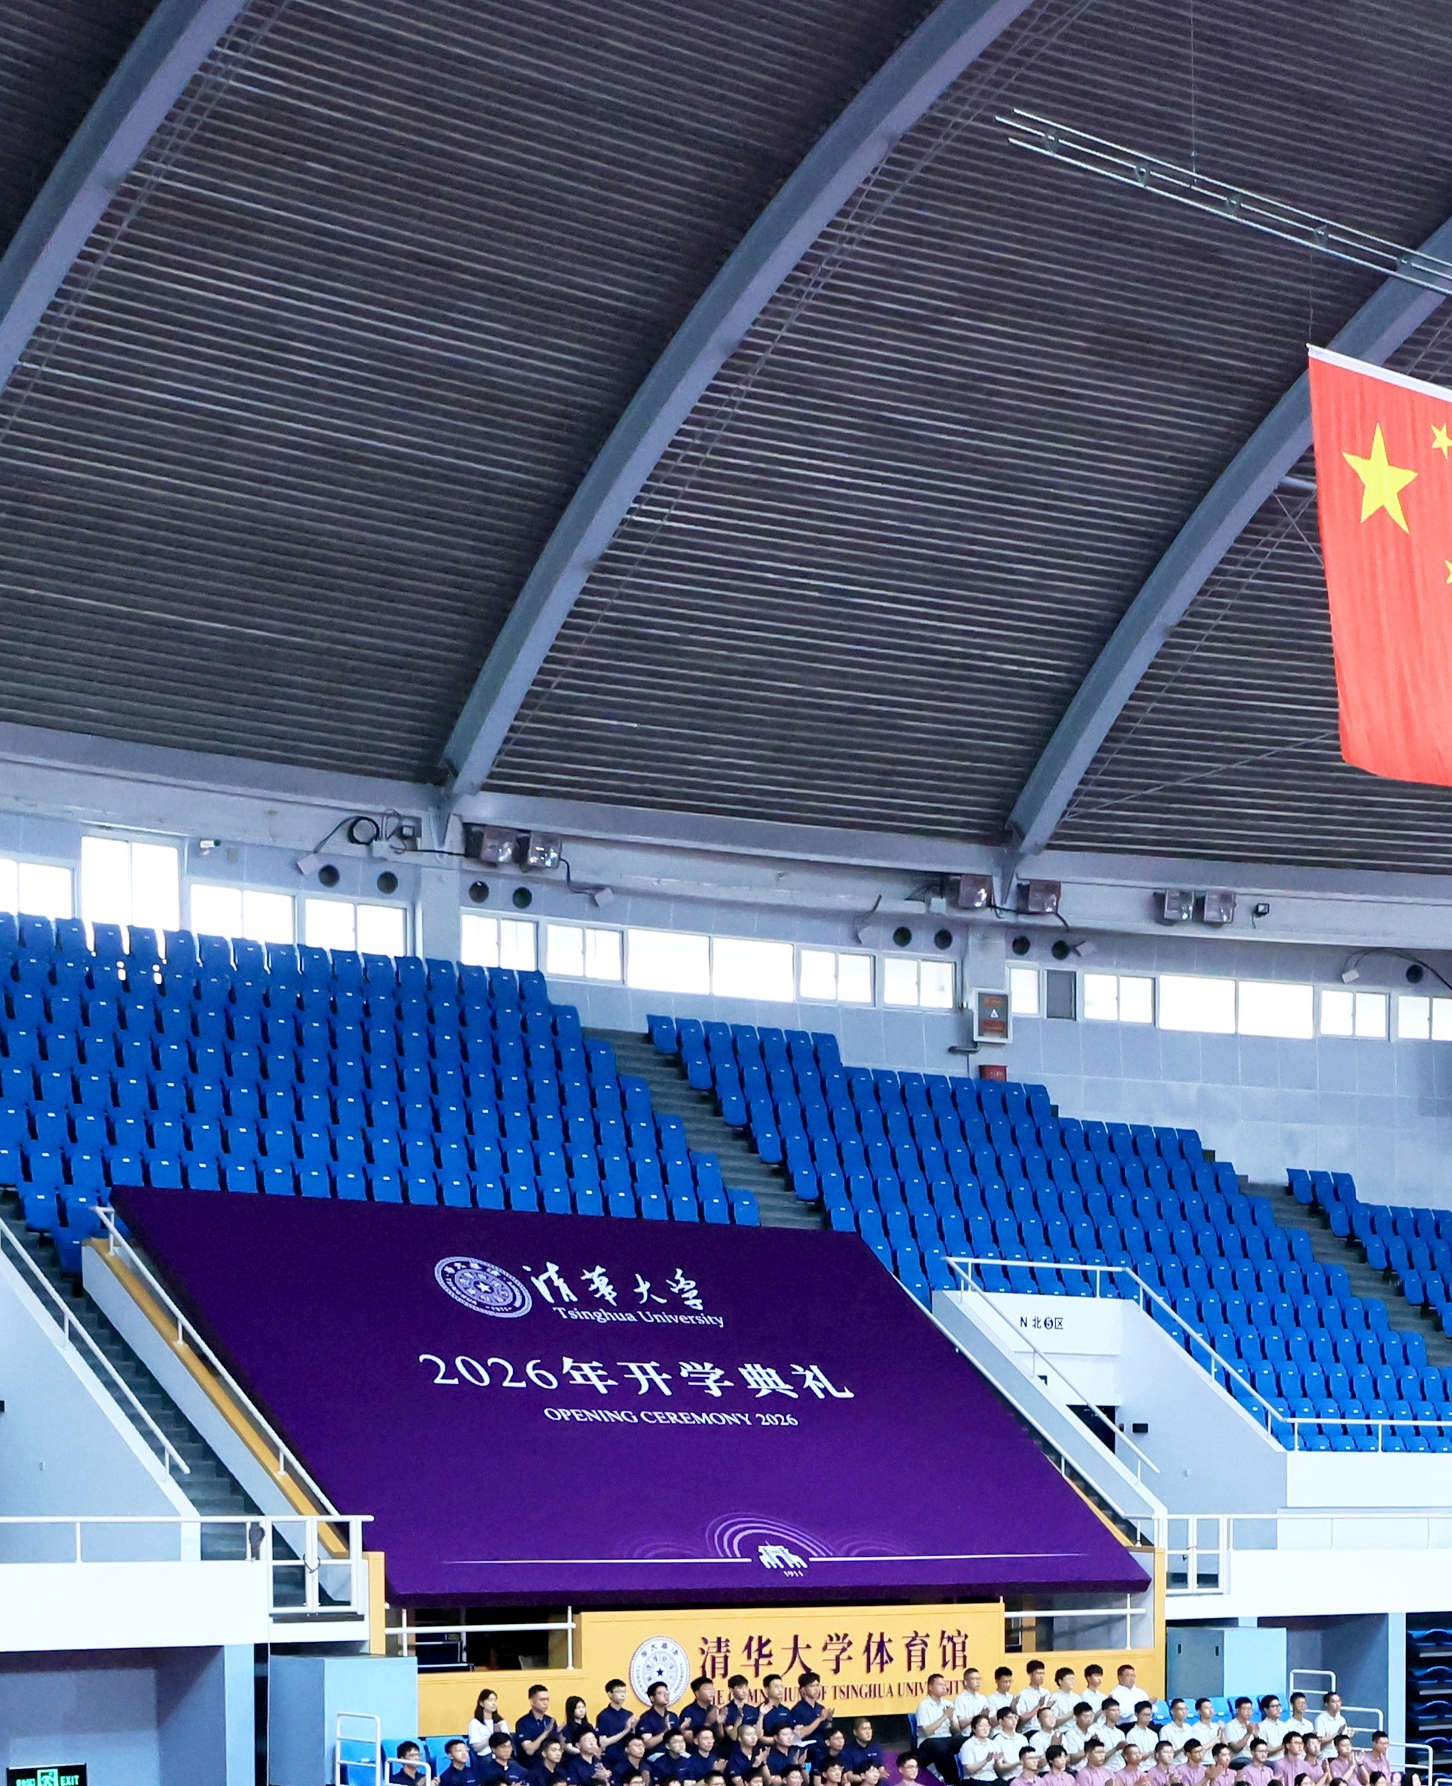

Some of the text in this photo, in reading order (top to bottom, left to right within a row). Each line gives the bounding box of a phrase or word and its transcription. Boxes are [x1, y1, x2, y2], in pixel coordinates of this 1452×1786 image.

[553, 1306, 724, 1328] Tsinghua University
[1020, 1316, 1028, 1328] N
[418, 1353, 855, 1399] 2026年开学典礼
[543, 1407, 800, 1427] OPENING CEREMONY 2026
[698, 1629, 969, 1679] 清华大学体育馆
[832, 1682, 894, 1700] TSINGHUA
[60, 1775, 79, 1786] EXIT
